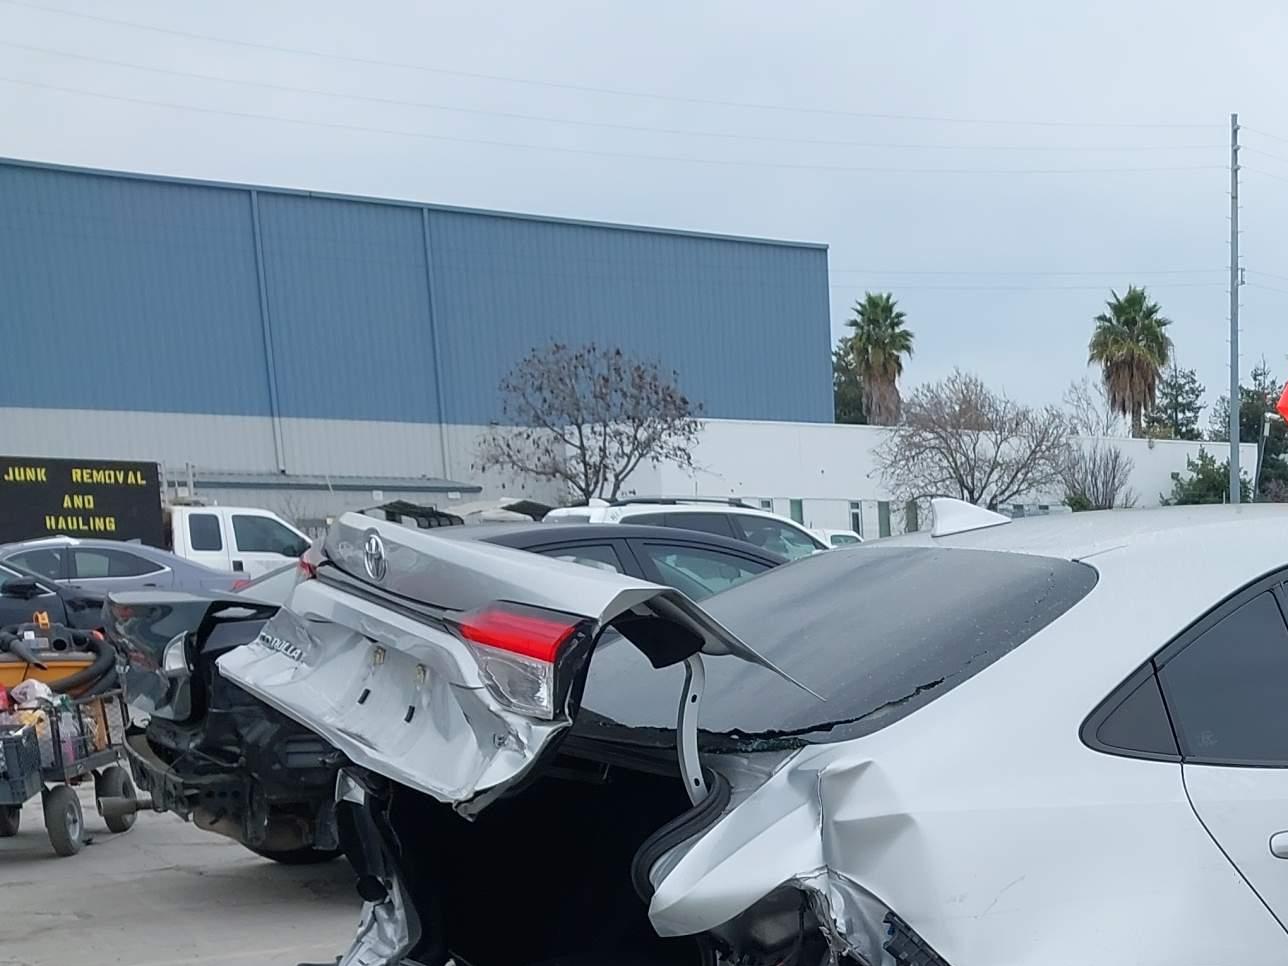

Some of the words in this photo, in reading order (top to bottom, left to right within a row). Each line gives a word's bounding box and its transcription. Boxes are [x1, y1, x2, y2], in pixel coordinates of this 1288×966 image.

[4, 466, 47, 481] JUNK
[71, 468, 146, 485] REMOVAL
[63, 494, 94, 509] AND
[45, 515, 116, 531] HAULING
